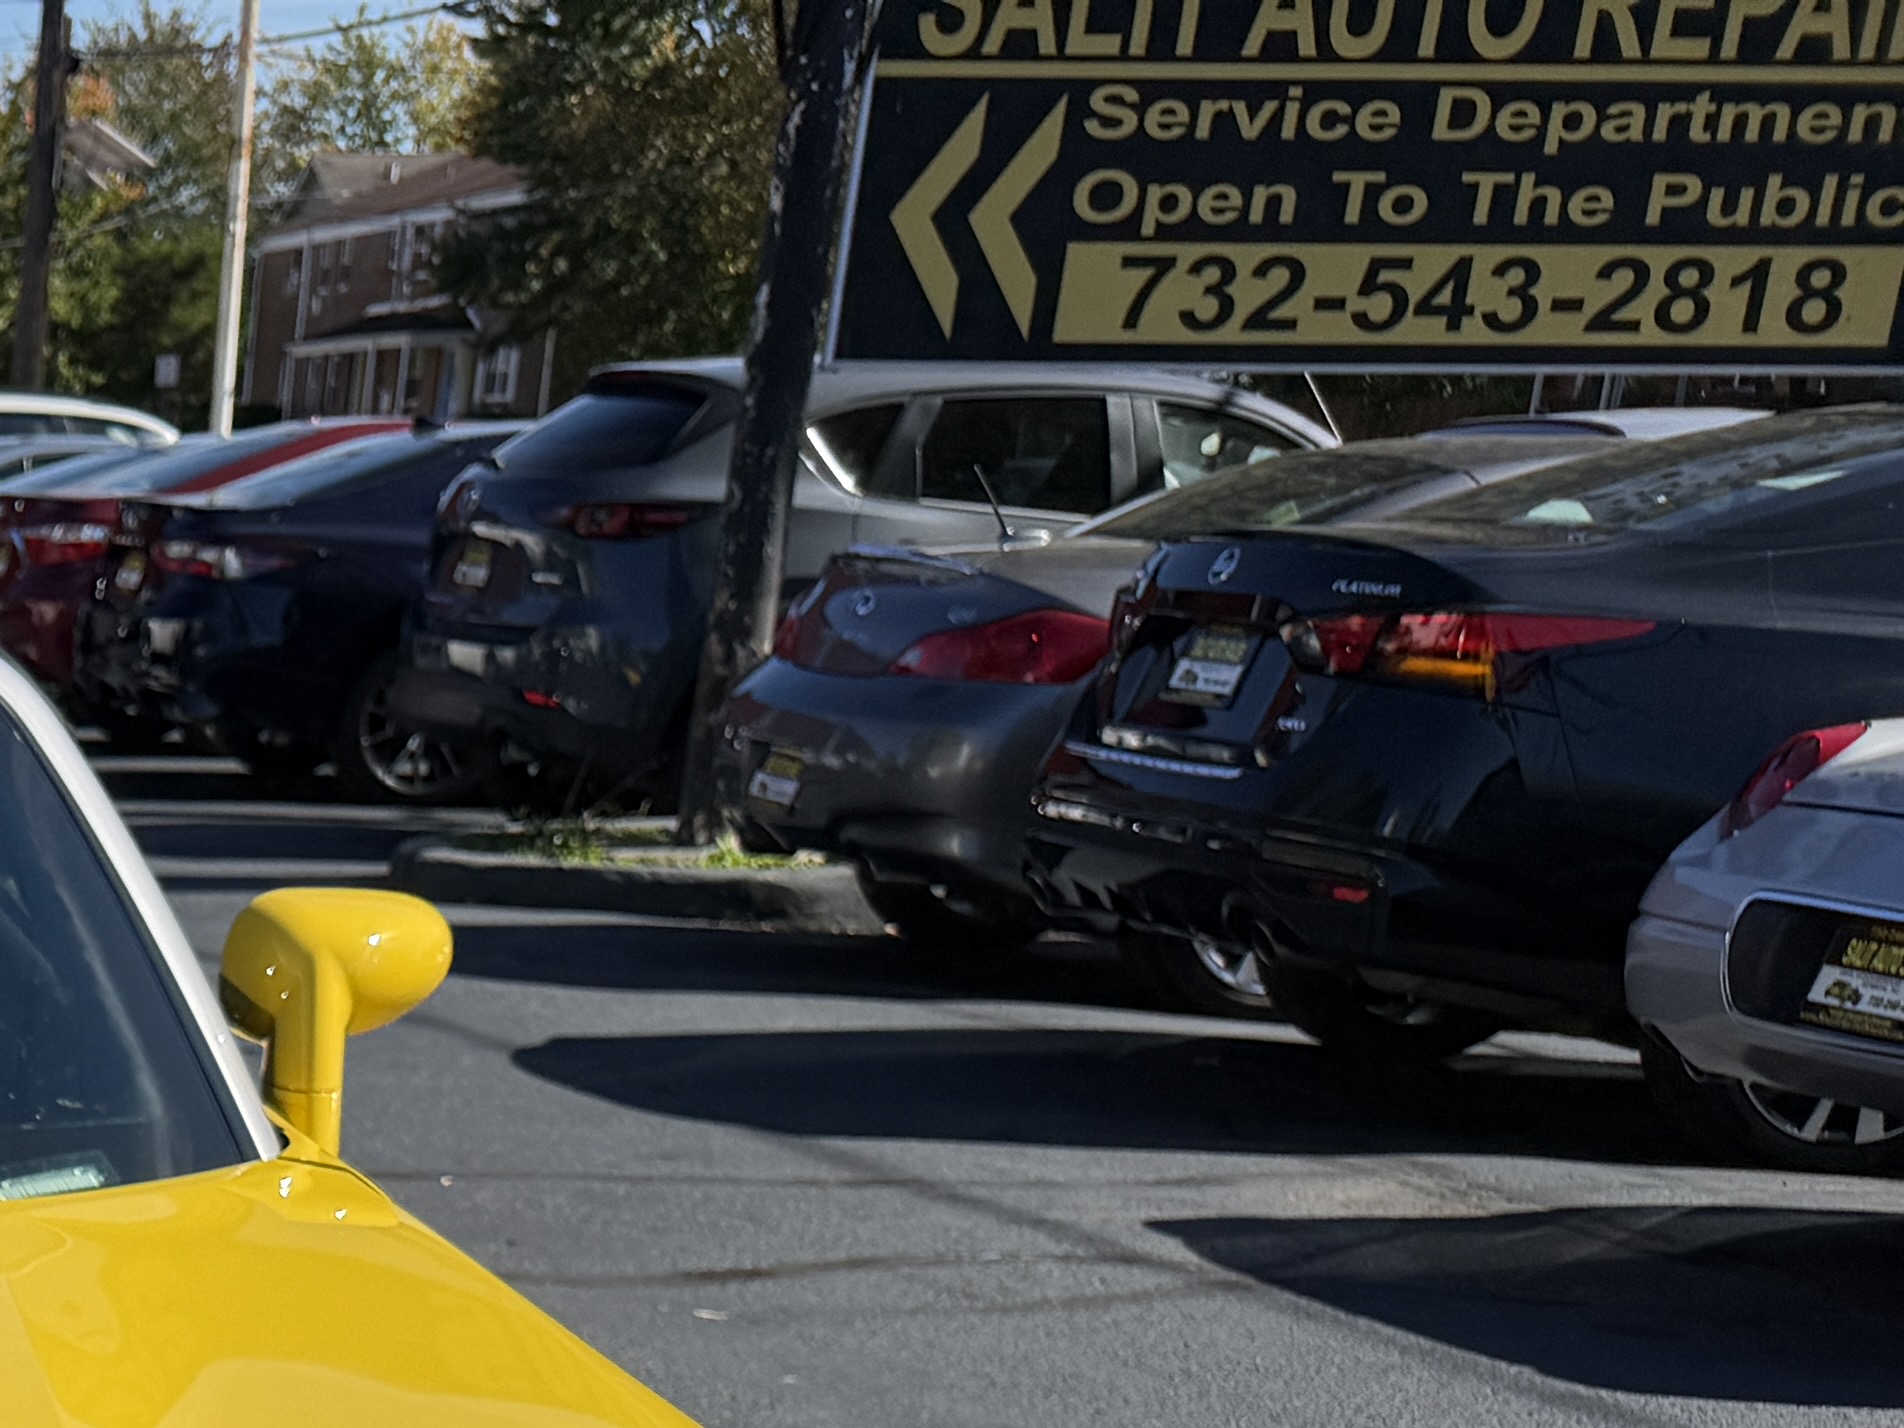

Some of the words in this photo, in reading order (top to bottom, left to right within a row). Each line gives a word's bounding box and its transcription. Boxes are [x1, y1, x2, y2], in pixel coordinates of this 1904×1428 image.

[1573, 0, 1904, 61] REPAI
[1083, 83, 1401, 142] Service
[1431, 85, 1904, 156] Departmen
[1072, 168, 1297, 238] Open
[1332, 170, 1429, 226] To
[1461, 171, 1615, 227] The
[1645, 172, 1904, 228] Public
[1120, 255, 1847, 334] 732-543-2818
